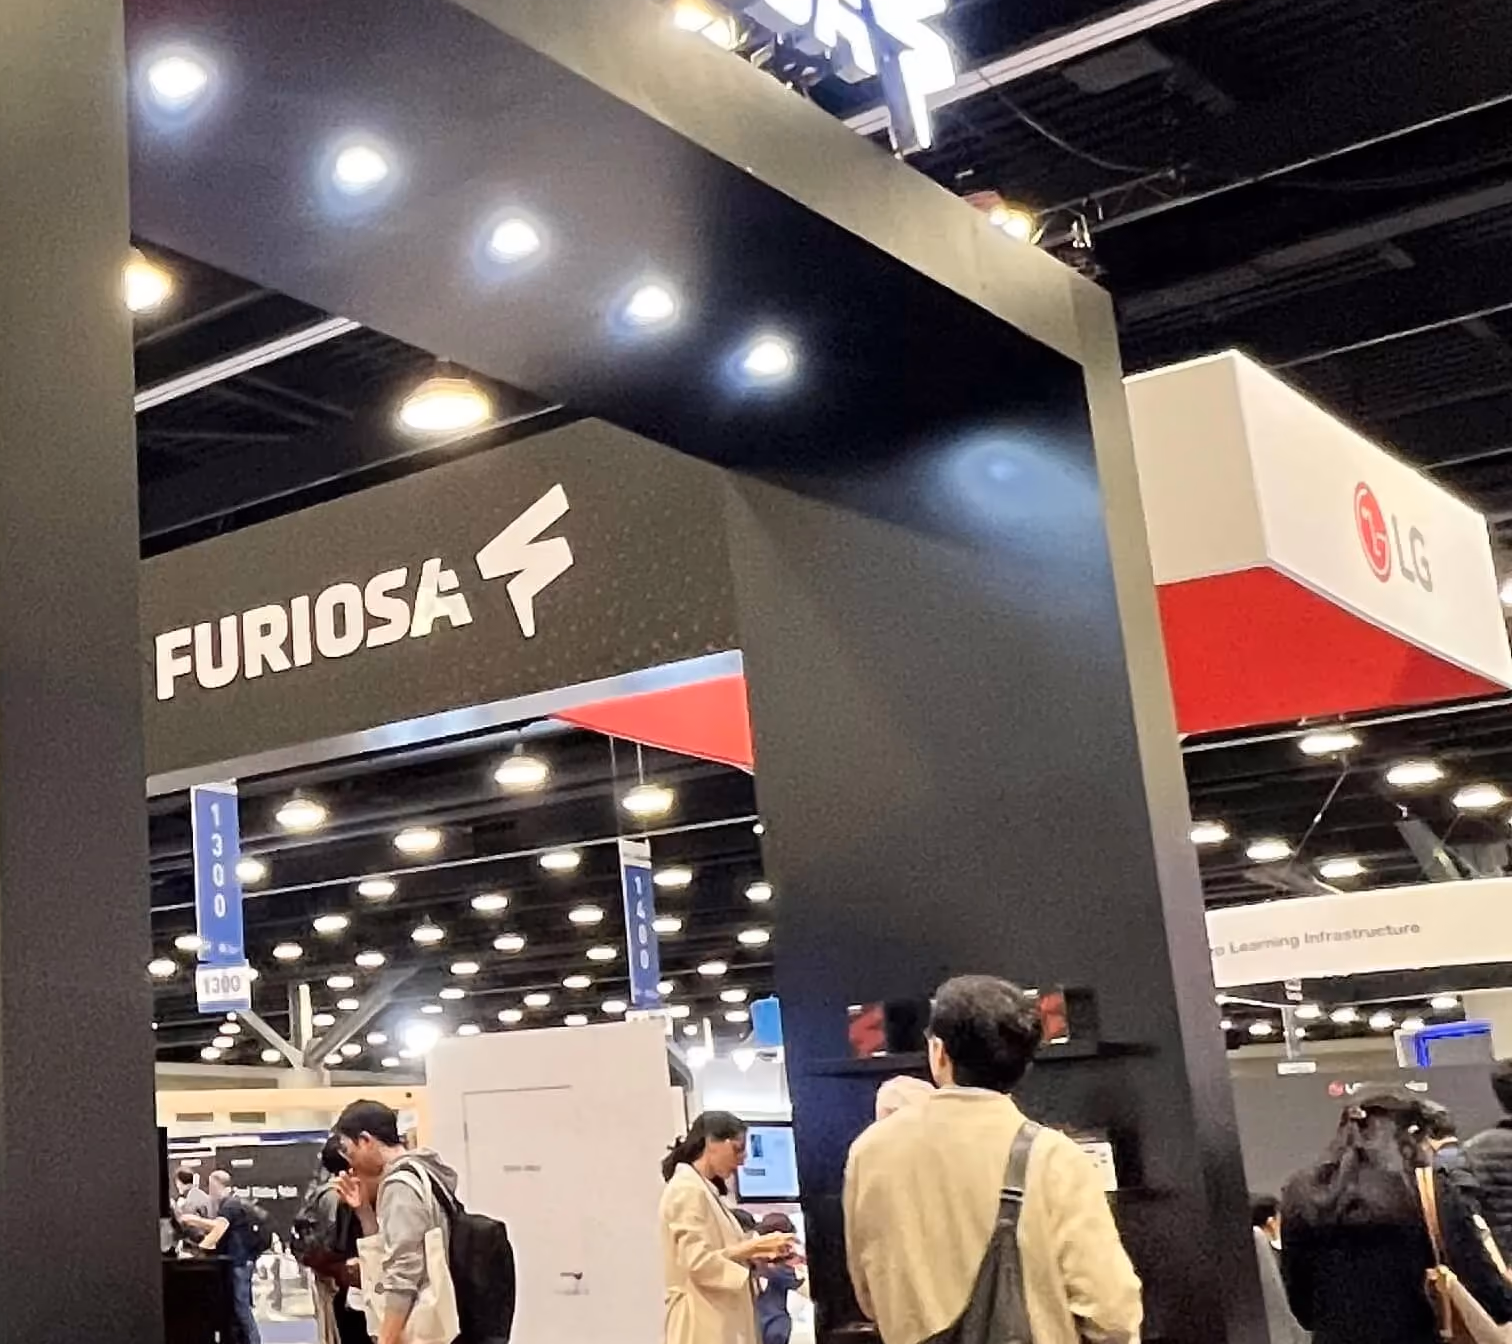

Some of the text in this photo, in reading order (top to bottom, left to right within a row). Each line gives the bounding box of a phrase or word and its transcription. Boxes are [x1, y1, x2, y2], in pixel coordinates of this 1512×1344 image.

[1391, 513, 1433, 593] LG
[154, 557, 473, 701] FURIOSA
[209, 802, 227, 919] 1300
[1229, 934, 1301, 955] Learning
[1304, 922, 1421, 945] Infrastructure
[202, 974, 242, 996] 1300
